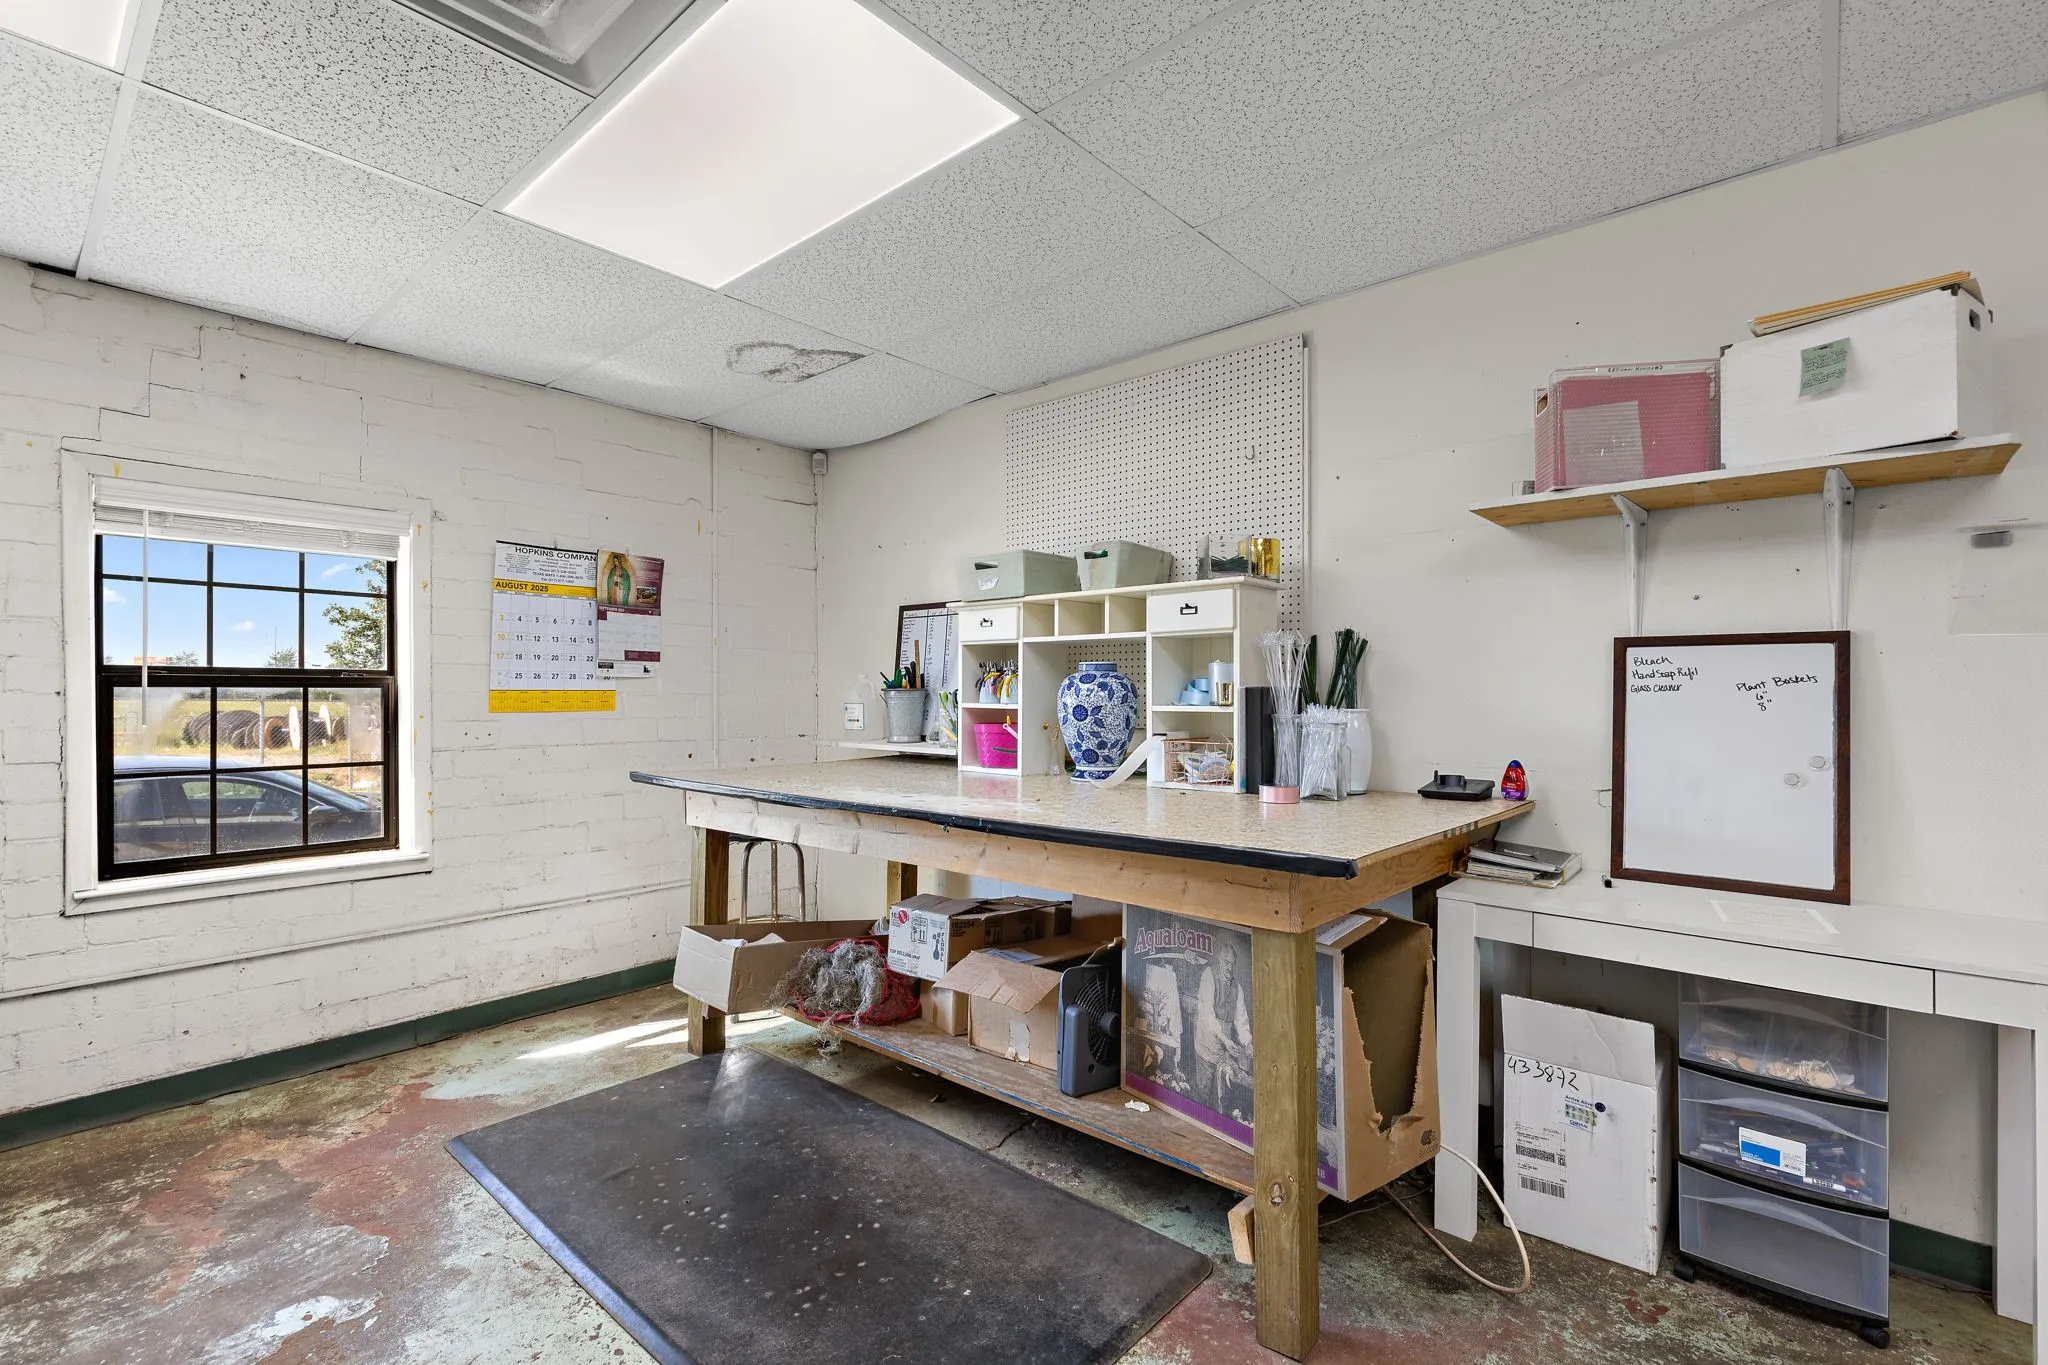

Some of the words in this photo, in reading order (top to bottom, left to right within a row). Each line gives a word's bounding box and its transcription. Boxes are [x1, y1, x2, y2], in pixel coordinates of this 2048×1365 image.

[515, 546, 554, 558] HOPKINS
[556, 552, 597, 562] COMPAN
[495, 581, 528, 591] AUGUST
[530, 584, 549, 592] 2025
[1633, 656, 1674, 666] Bleach
[1632, 669, 1655, 680] Hand
[1630, 684, 1652, 694] Glass
[1736, 681, 1767, 692] Plant
[1771, 674, 1818, 687] Baskets
[1134, 921, 1214, 956] Aquafoam
[1507, 1055, 1579, 1091] 433872
